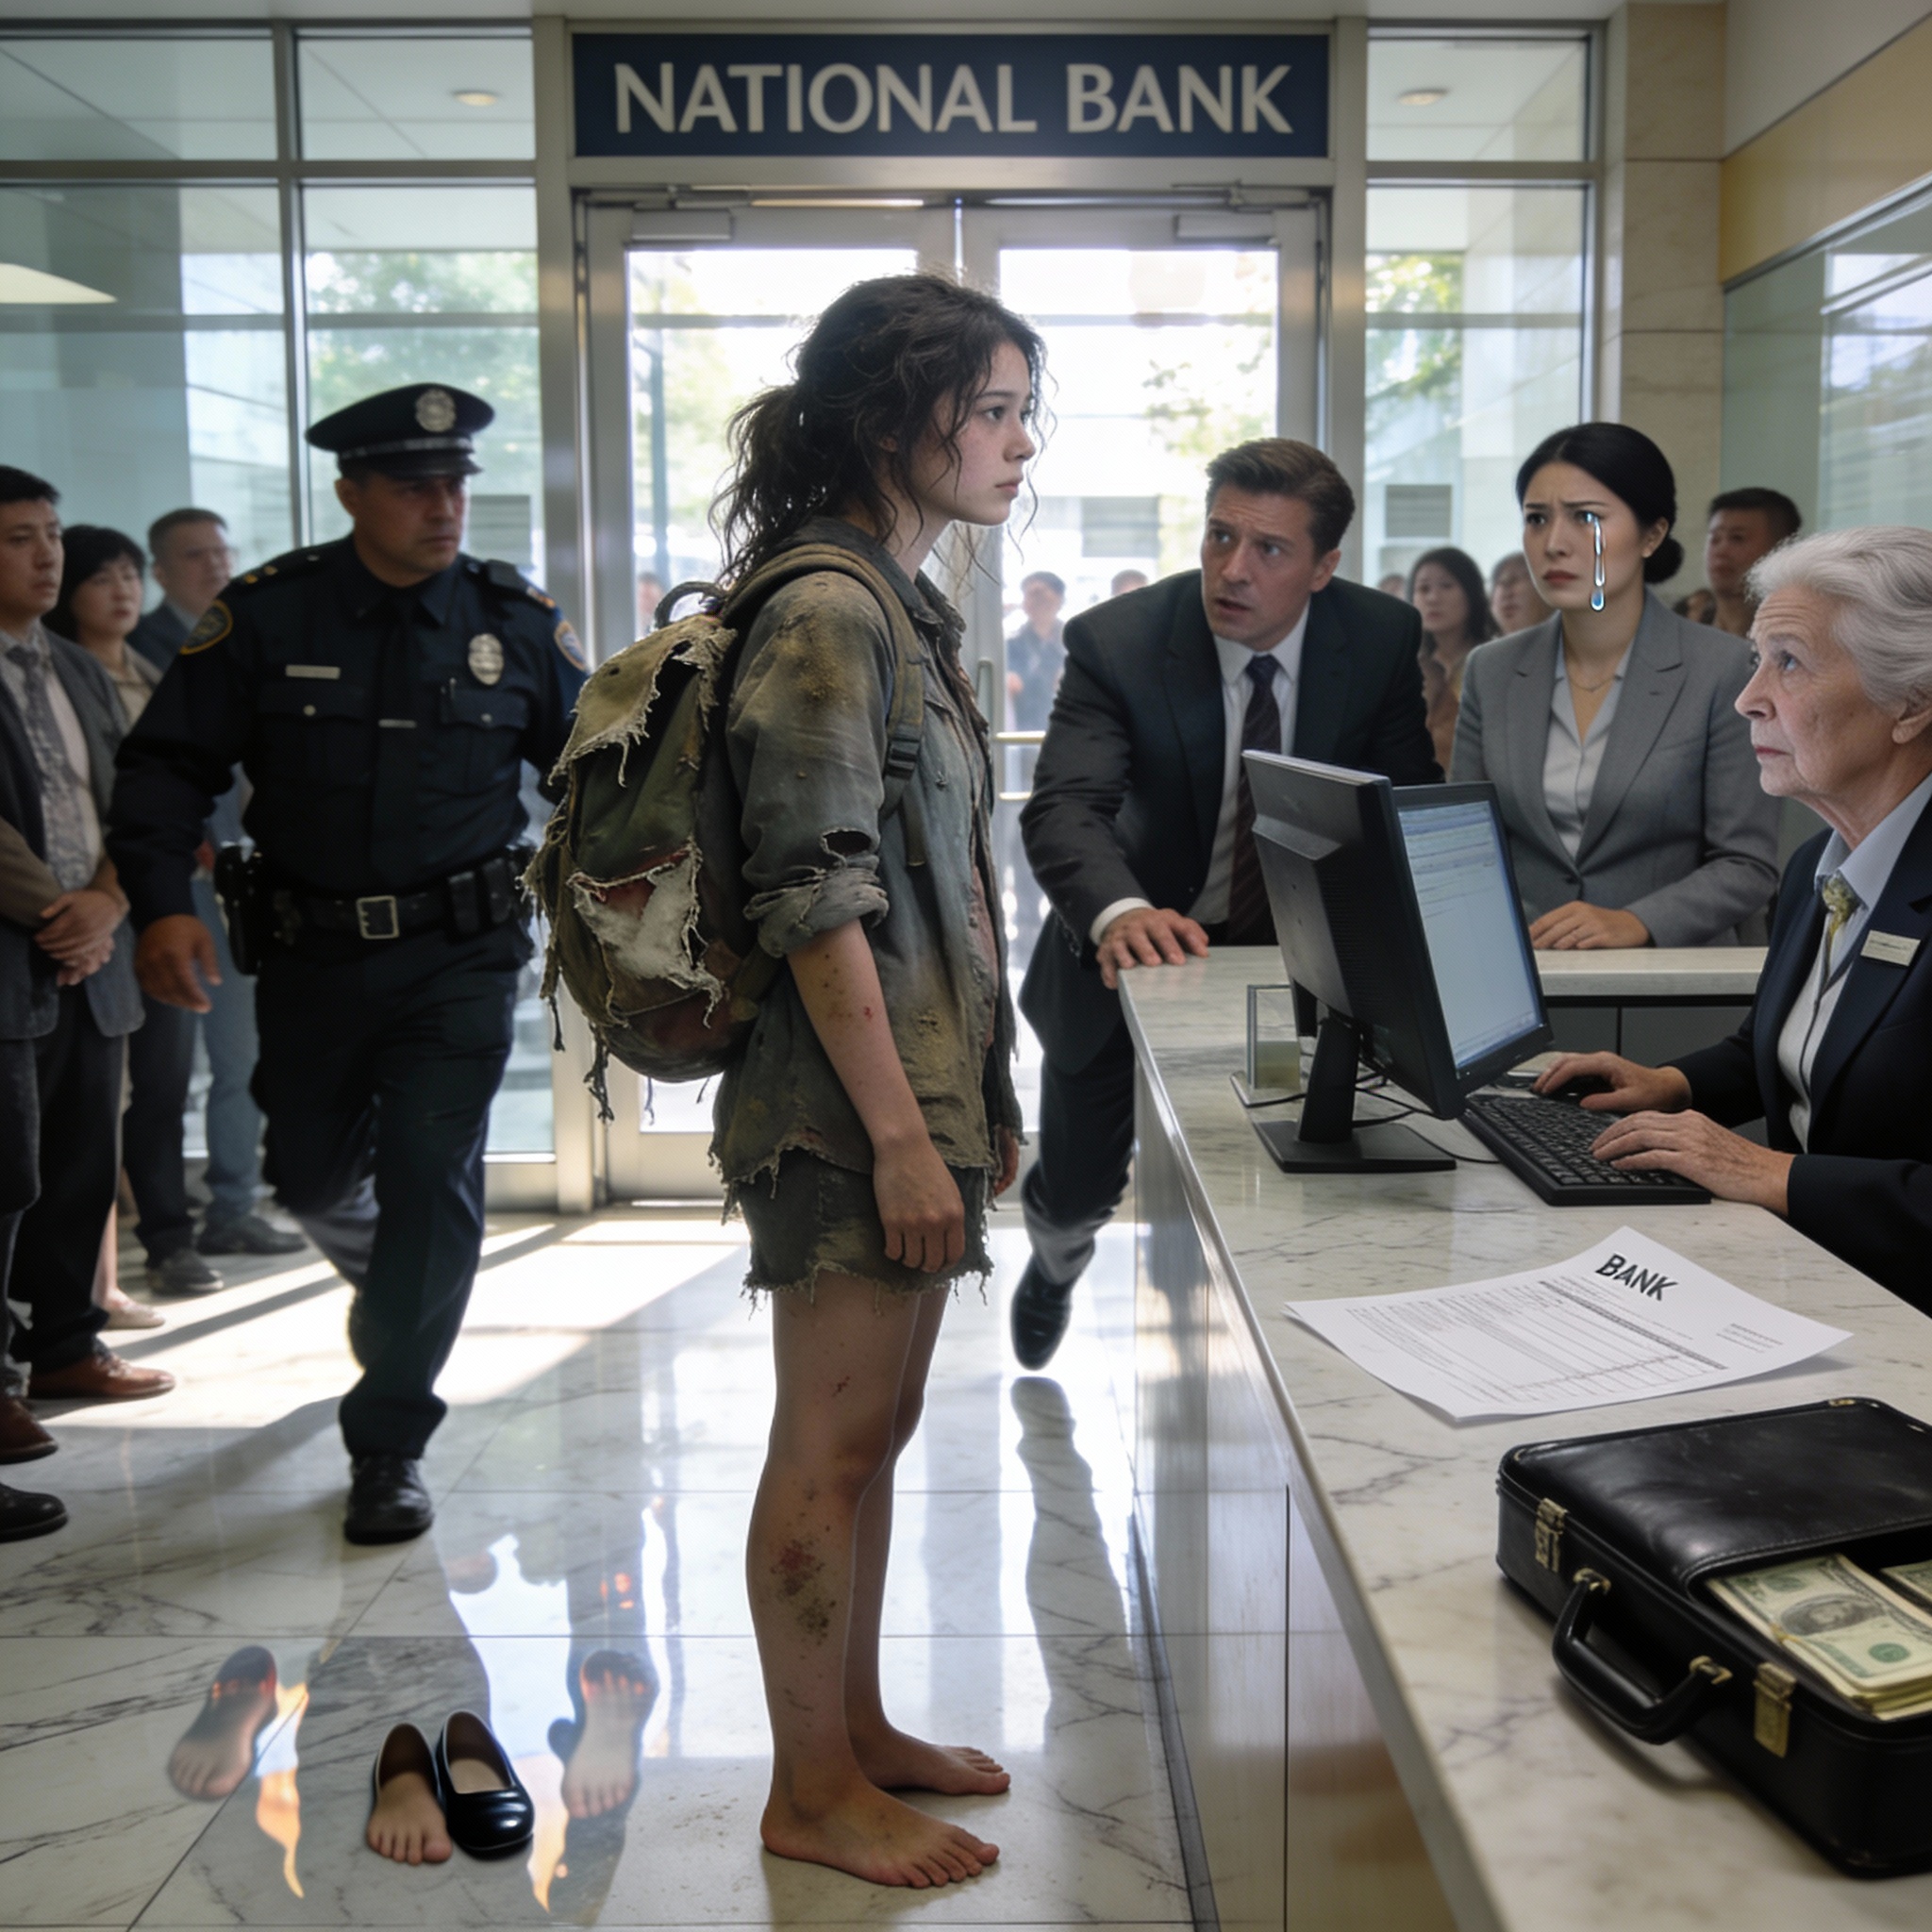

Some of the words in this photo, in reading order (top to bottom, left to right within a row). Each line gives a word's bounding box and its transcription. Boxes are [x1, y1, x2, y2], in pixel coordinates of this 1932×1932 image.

[615, 62, 1038, 134] NATIONAL
[1067, 64, 1293, 134] BANK
[1594, 1253, 1679, 1302] BANK
